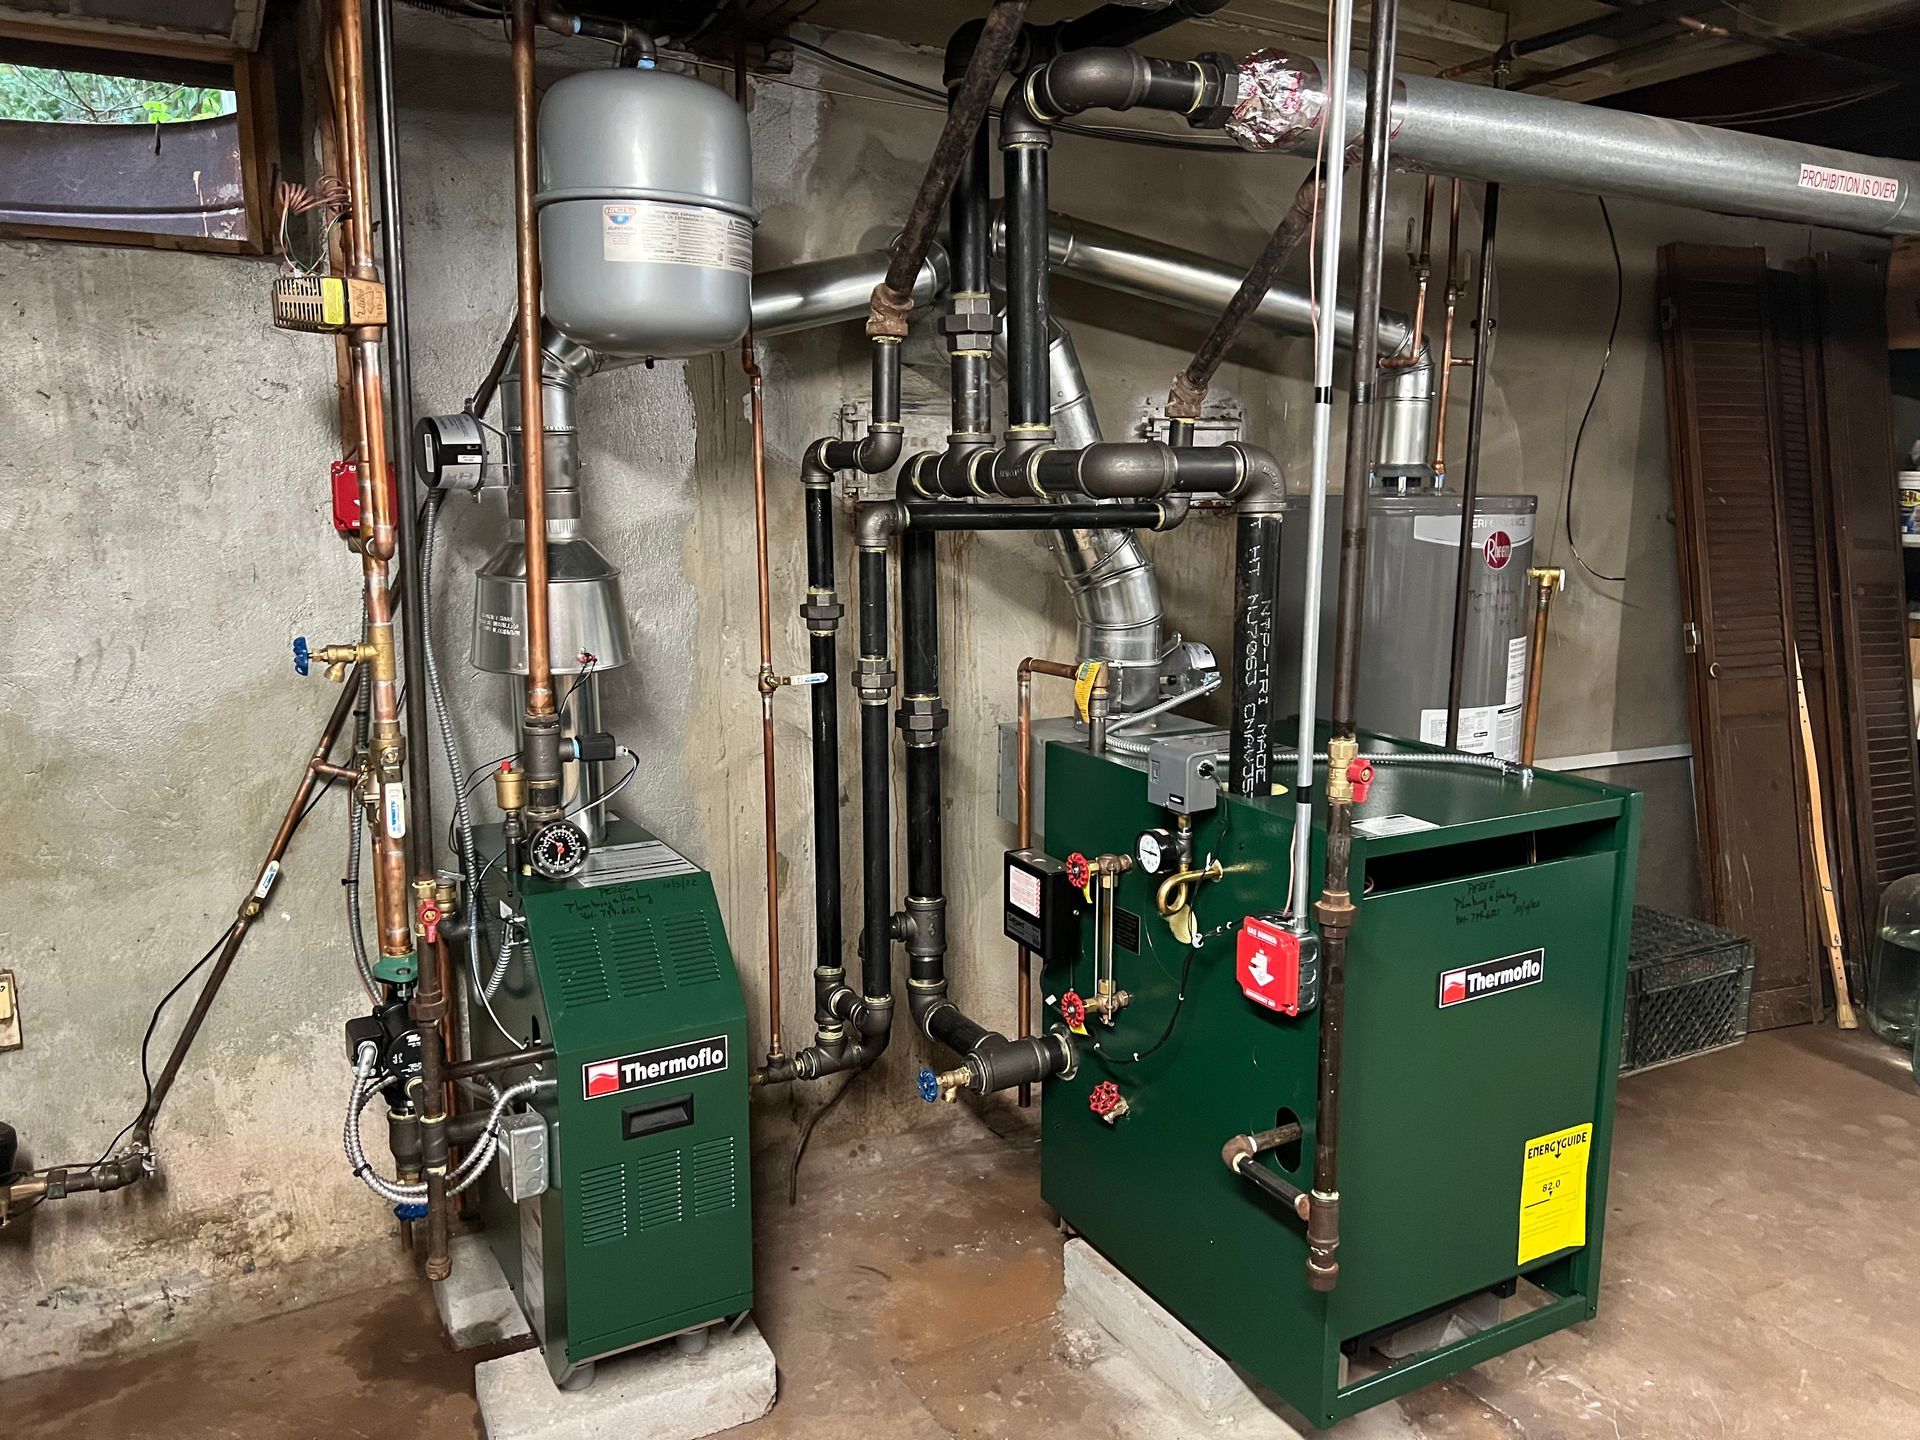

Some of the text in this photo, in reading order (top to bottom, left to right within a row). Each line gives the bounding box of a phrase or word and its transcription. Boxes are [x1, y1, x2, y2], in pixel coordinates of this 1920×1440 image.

[1801, 169, 1897, 199] PROHIBITION IS OVER
[1248, 545, 1262, 577] HT
[1486, 532, 1511, 564] Rheem
[1256, 723, 1268, 784] MADE
[1467, 959, 1541, 993] Thermoflo
[621, 1047, 724, 1084] Thermoflo
[1528, 1131, 1588, 1159] ENERGYGUIDE
[1542, 1179, 1561, 1192] 82.0
